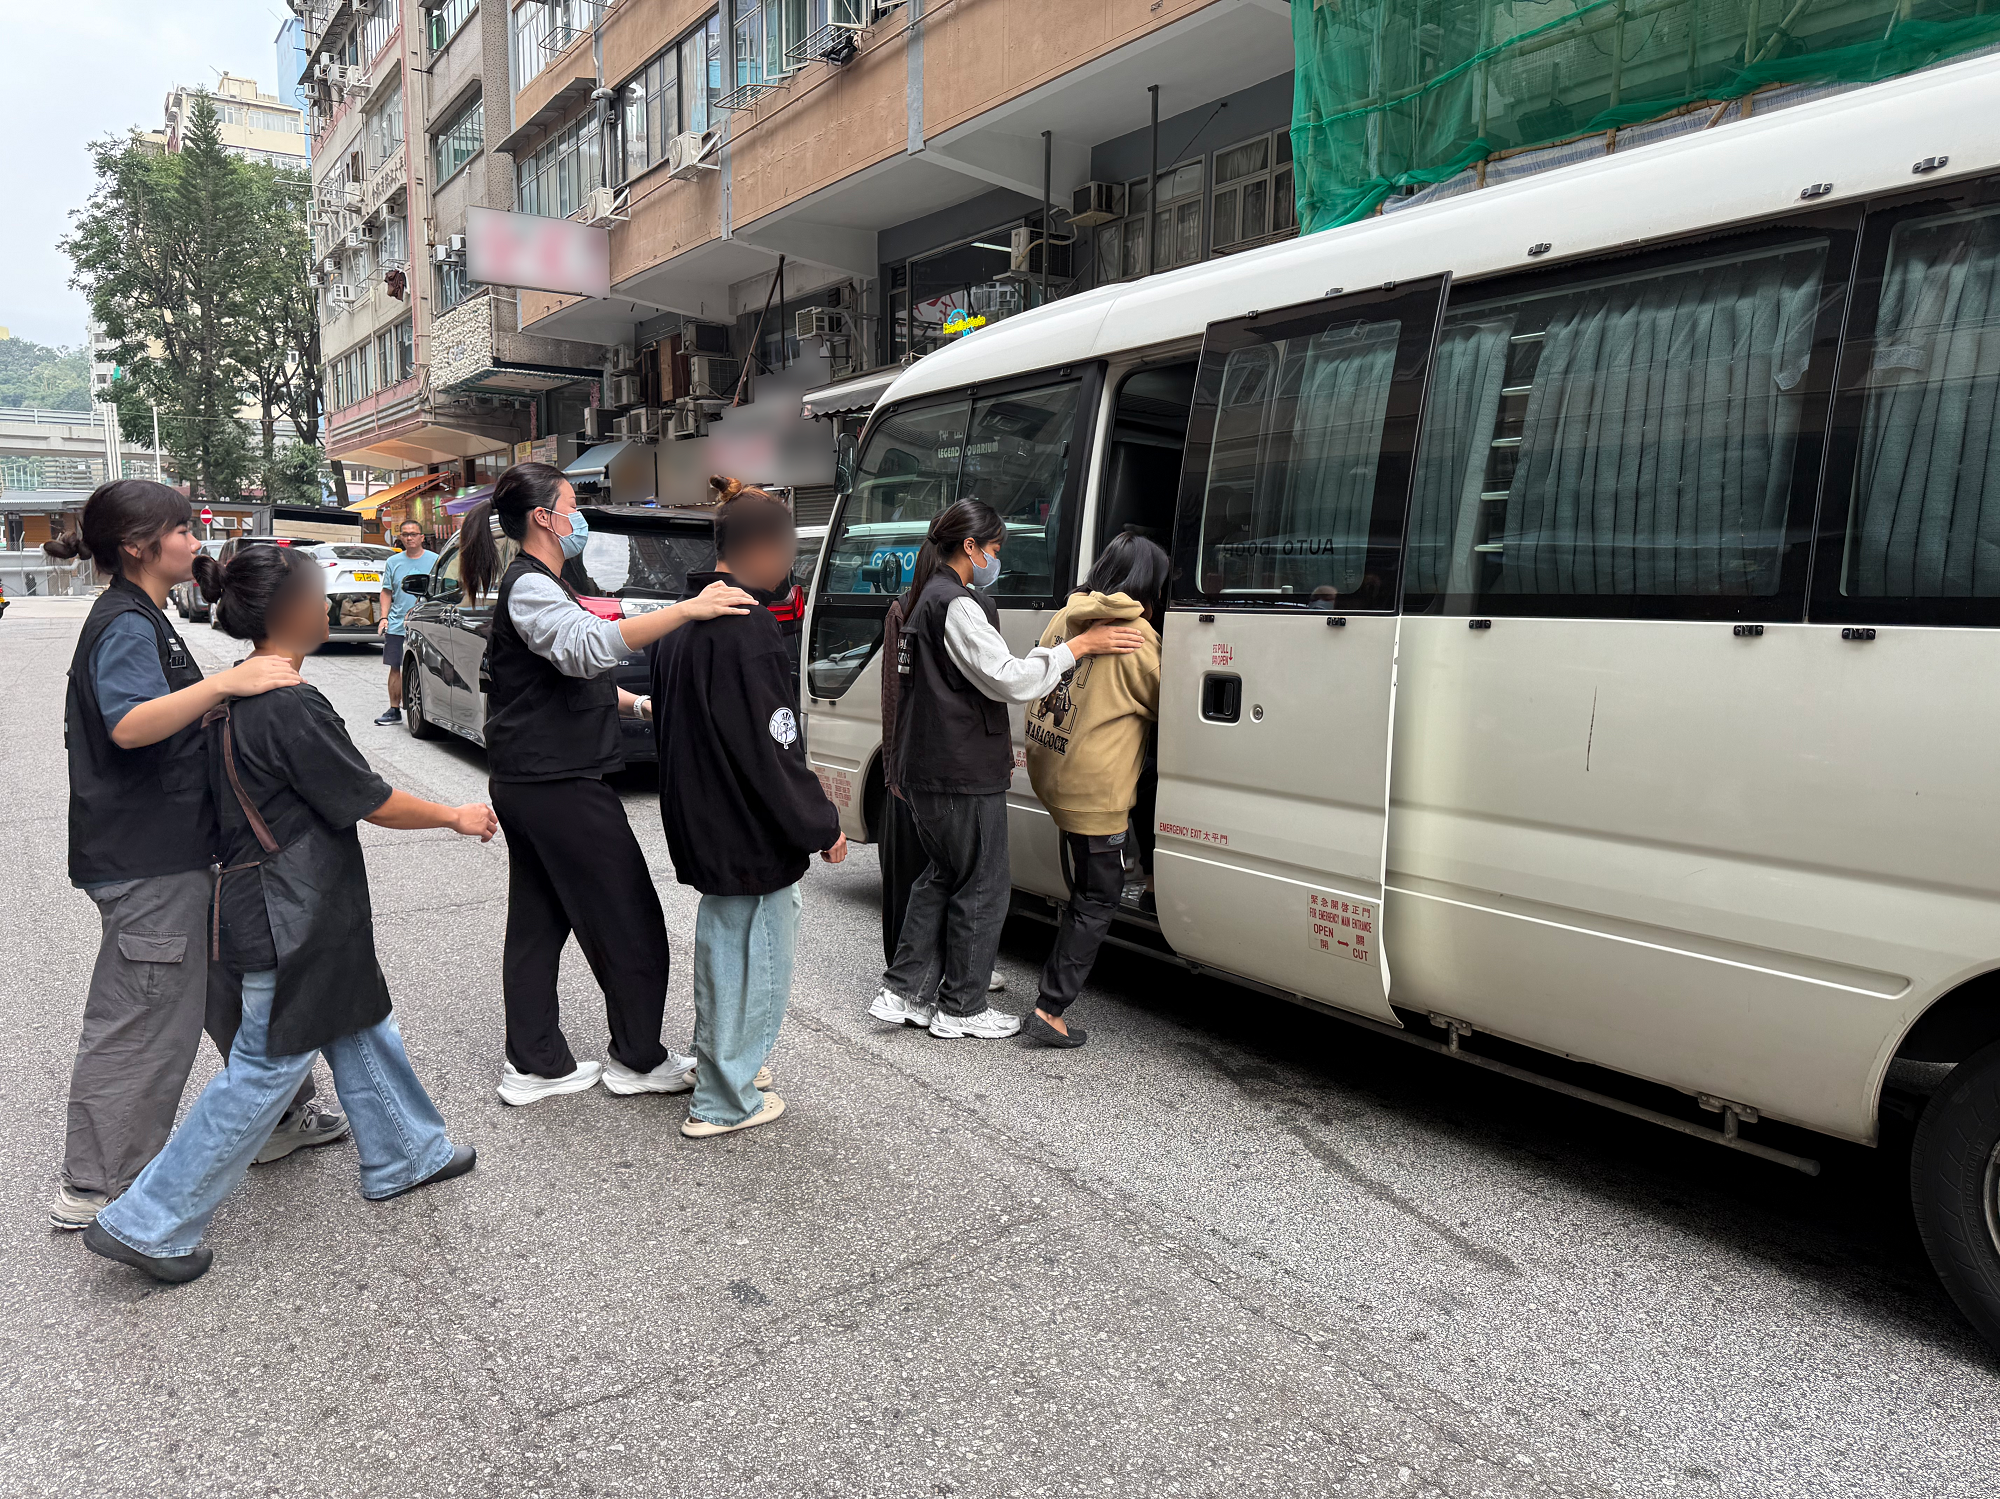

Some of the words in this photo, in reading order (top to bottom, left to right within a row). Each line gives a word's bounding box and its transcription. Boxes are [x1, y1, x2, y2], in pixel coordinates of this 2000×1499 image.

[938, 446, 960, 458] LEGEND
[964, 441, 999, 456] QUARIUM
[1159, 822, 1190, 837] EMERGENCY
[1190, 828, 1203, 840] EXIT
[1203, 831, 1229, 845] 太平門
[1309, 907, 1317, 919] FOR
[1318, 909, 1340, 925] EMERGENCY
[1340, 915, 1351, 928] MAIN
[1351, 918, 1372, 934] ENTRANCE
[1313, 923, 1334, 939] OPEN
[1352, 948, 1369, 961] CUT
